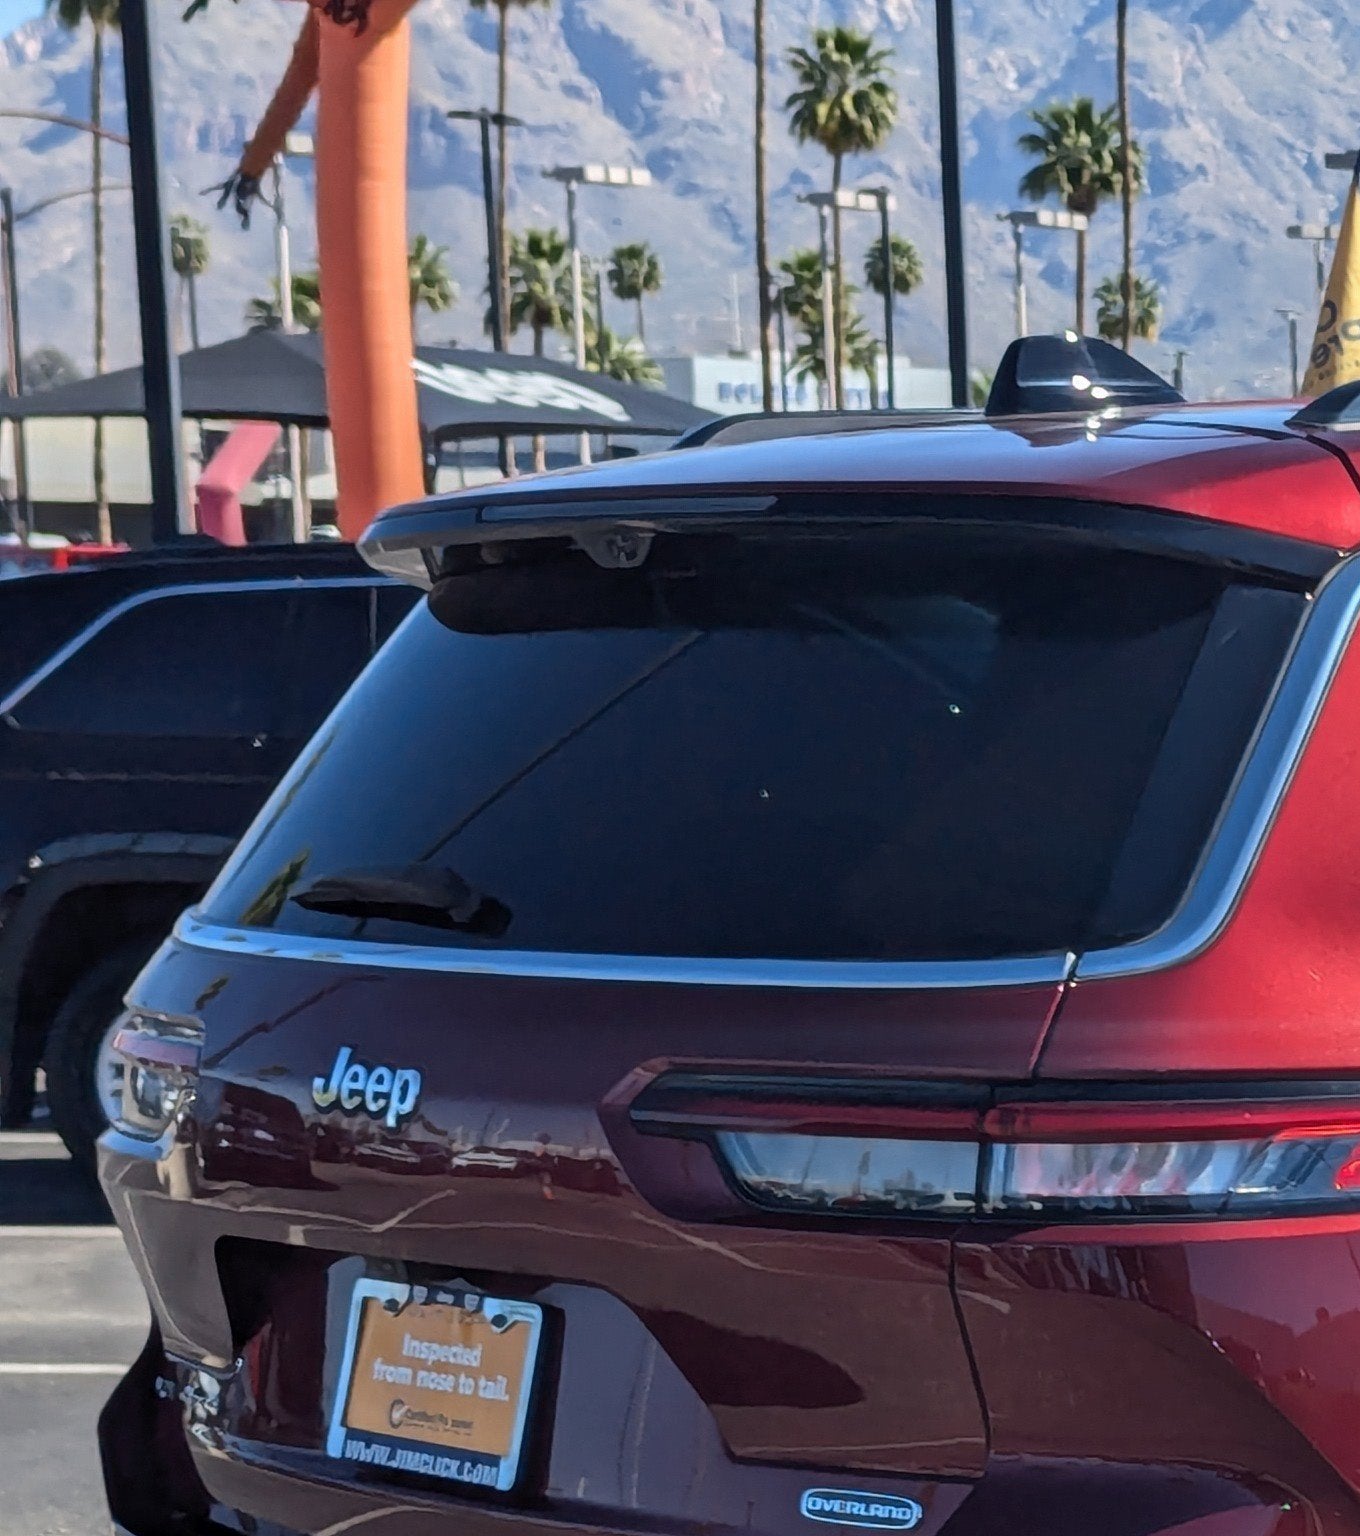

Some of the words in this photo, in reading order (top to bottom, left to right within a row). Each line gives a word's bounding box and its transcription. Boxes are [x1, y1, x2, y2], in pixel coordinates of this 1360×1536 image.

[312, 1046, 421, 1127] Jeep
[402, 1332, 482, 1367] Inspected
[373, 1357, 412, 1386] from
[416, 1369, 455, 1392] nose
[458, 1372, 475, 1395] to
[806, 1496, 912, 1520] OVERLAND
